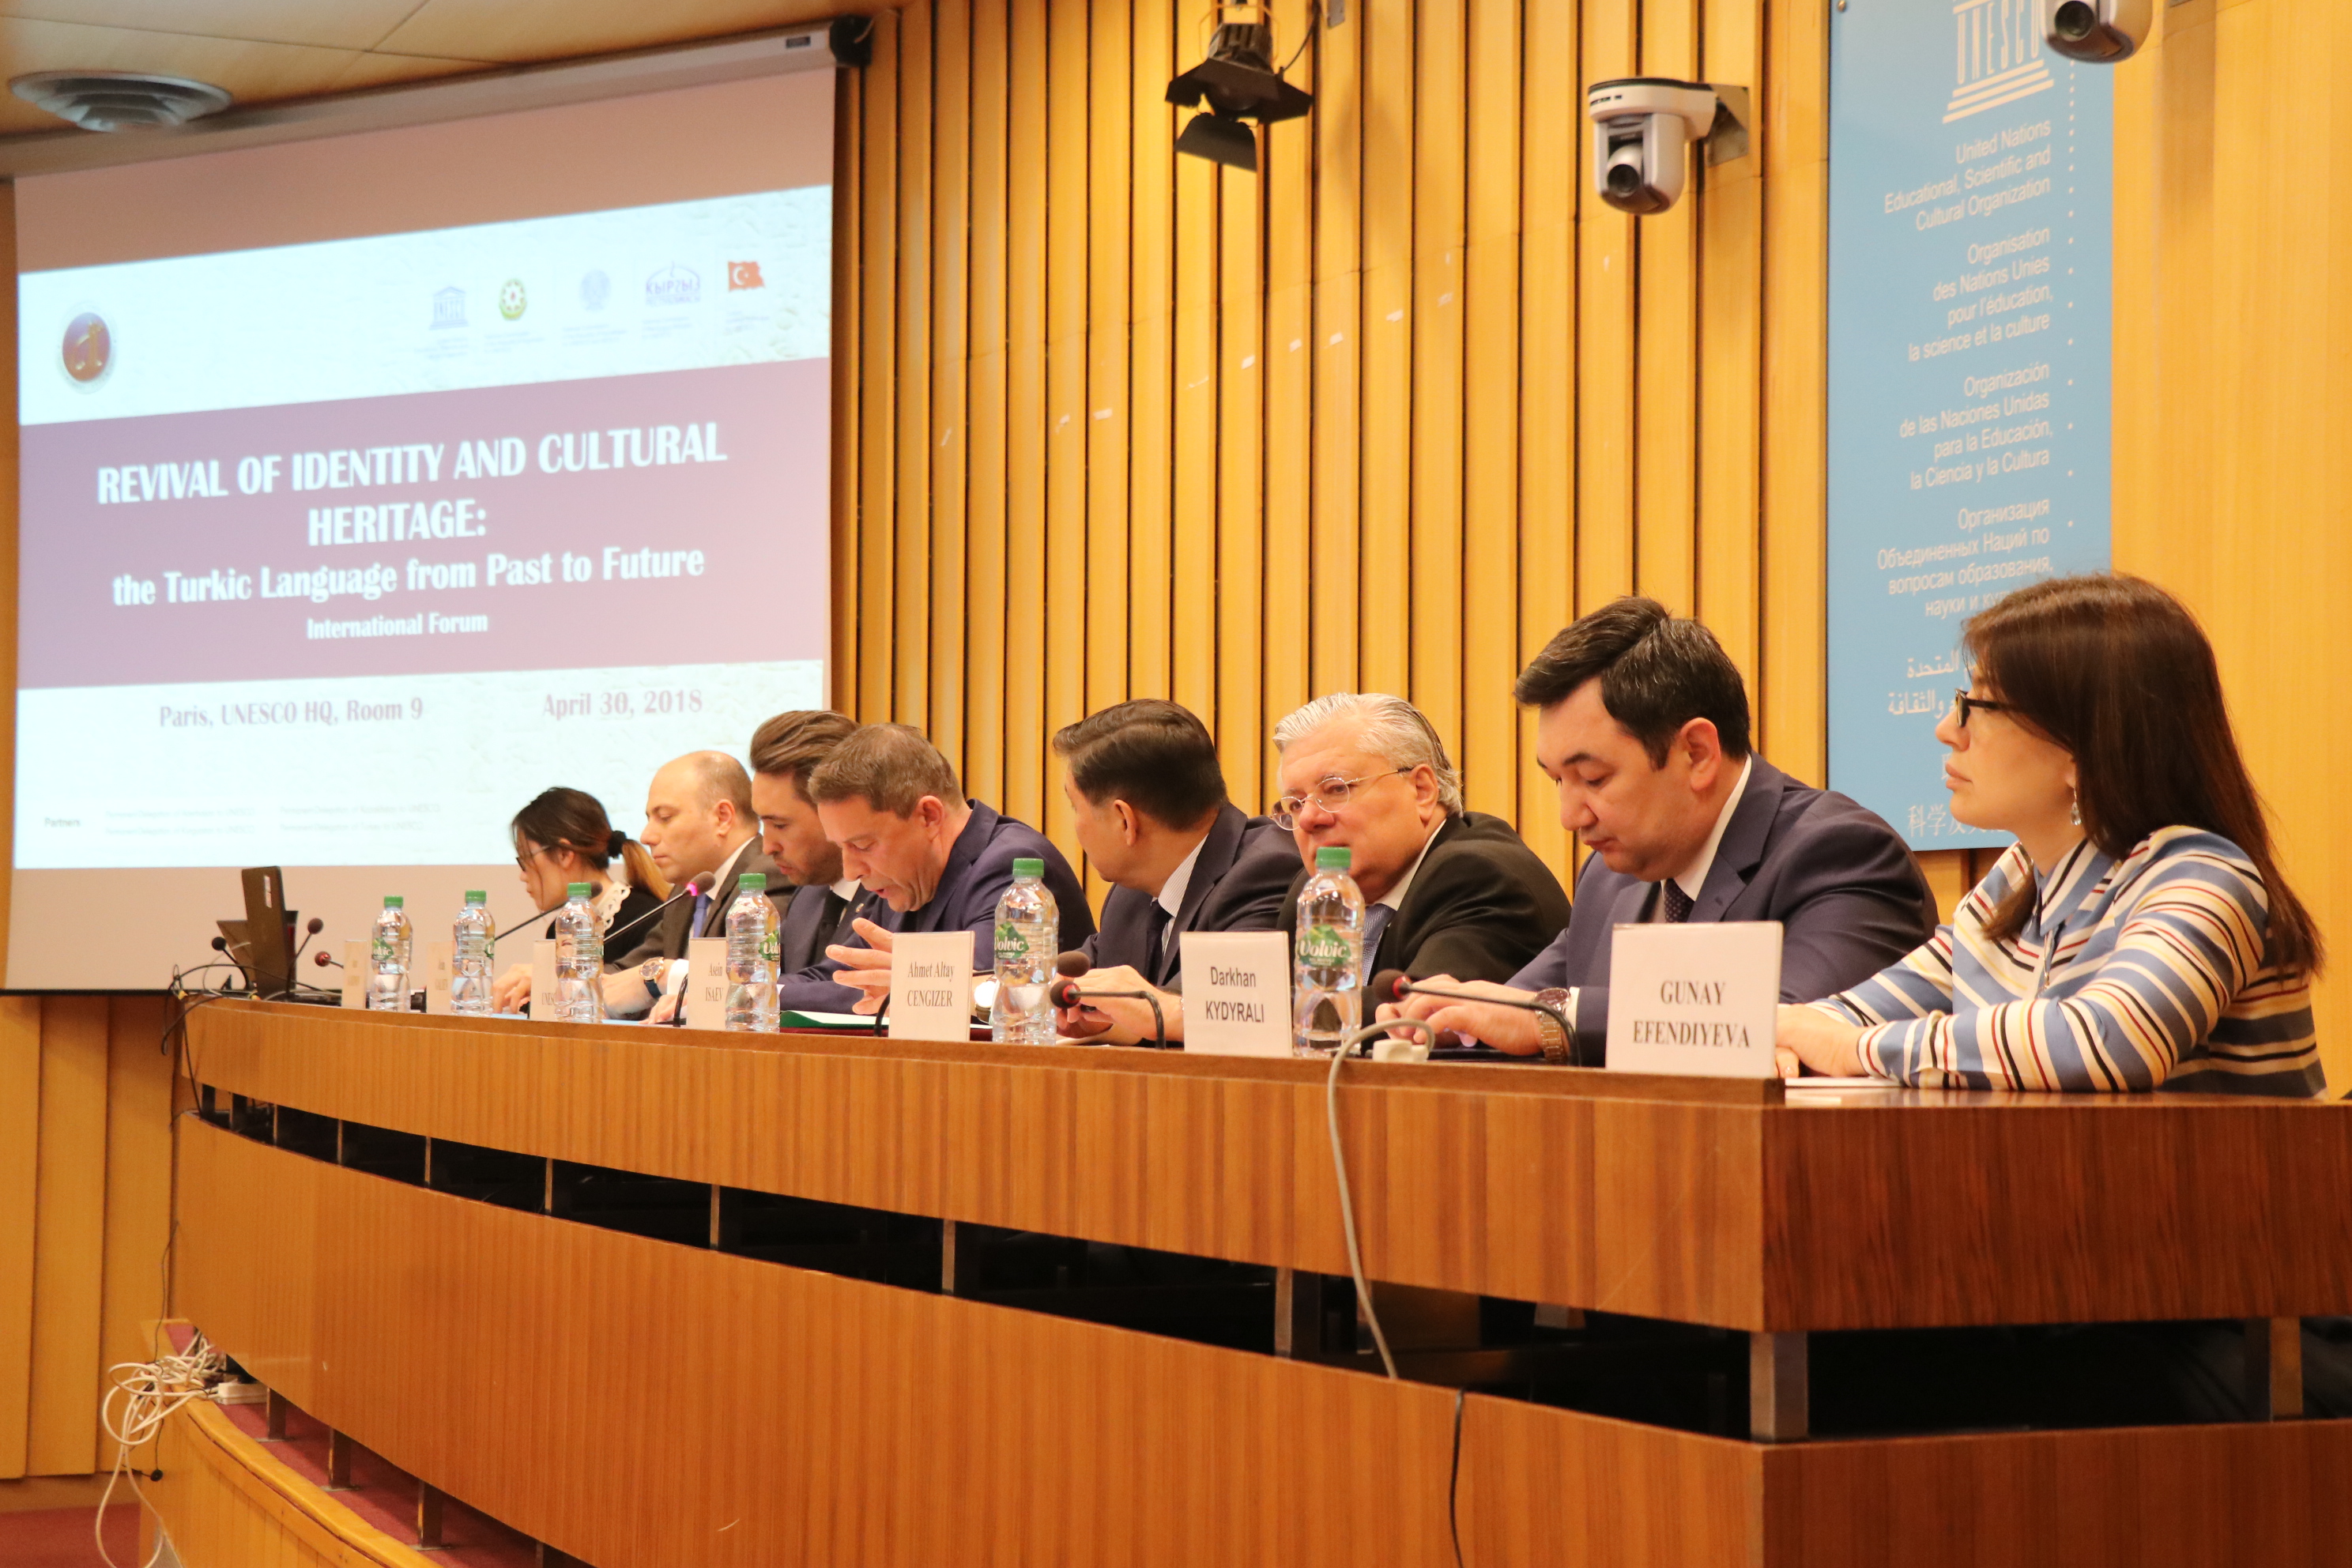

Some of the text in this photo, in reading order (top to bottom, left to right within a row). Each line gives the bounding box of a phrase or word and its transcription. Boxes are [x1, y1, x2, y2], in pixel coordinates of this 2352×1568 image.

[1955, 120, 2051, 164] United Nations
[1884, 144, 2051, 213] Educational, Scientific and
[1916, 177, 2050, 231] Cultural Organization
[1967, 228, 2050, 265] Organisation
[1933, 255, 2050, 301] des Nations Unies
[1947, 303, 1977, 330] pour
[1909, 313, 2050, 361] la science et la culture
[1964, 361, 2049, 398] Organización
[1899, 391, 2049, 438] de las Naciones Unidas
[1934, 418, 2052, 463] para la Educación,
[97, 421, 728, 504] REVIVAL OF IDENTITY AND CULTURAL
[1910, 449, 2049, 490] la Ciencia y la Cultura
[307, 499, 487, 546] HERITAGE:
[1958, 499, 2049, 533] Организация
[1877, 528, 2050, 570] Объединенных Наций по
[112, 546, 705, 607] the Turkic Language from Past to Future
[1889, 571, 1954, 596] вопросам
[1925, 596, 1966, 620] науки
[1969, 595, 1978, 610] и
[306, 611, 489, 640] International Forum
[160, 696, 424, 729] Paris, UNESCO HQ, Room 9
[542, 688, 703, 721] April 30, 2018
[1299, 939, 1347, 958] Volvic
[708, 963, 723, 977] Asein
[907, 961, 955, 982] Ahmet Altay
[1211, 967, 1257, 987] Darkhan
[705, 987, 723, 1001] ISAEV
[906, 989, 953, 1007] CENGIZER
[1660, 980, 1726, 1005] GUNAY
[1205, 1001, 1265, 1023] KYDYRALI
[1633, 1020, 1751, 1048] EFENDIYEVA
